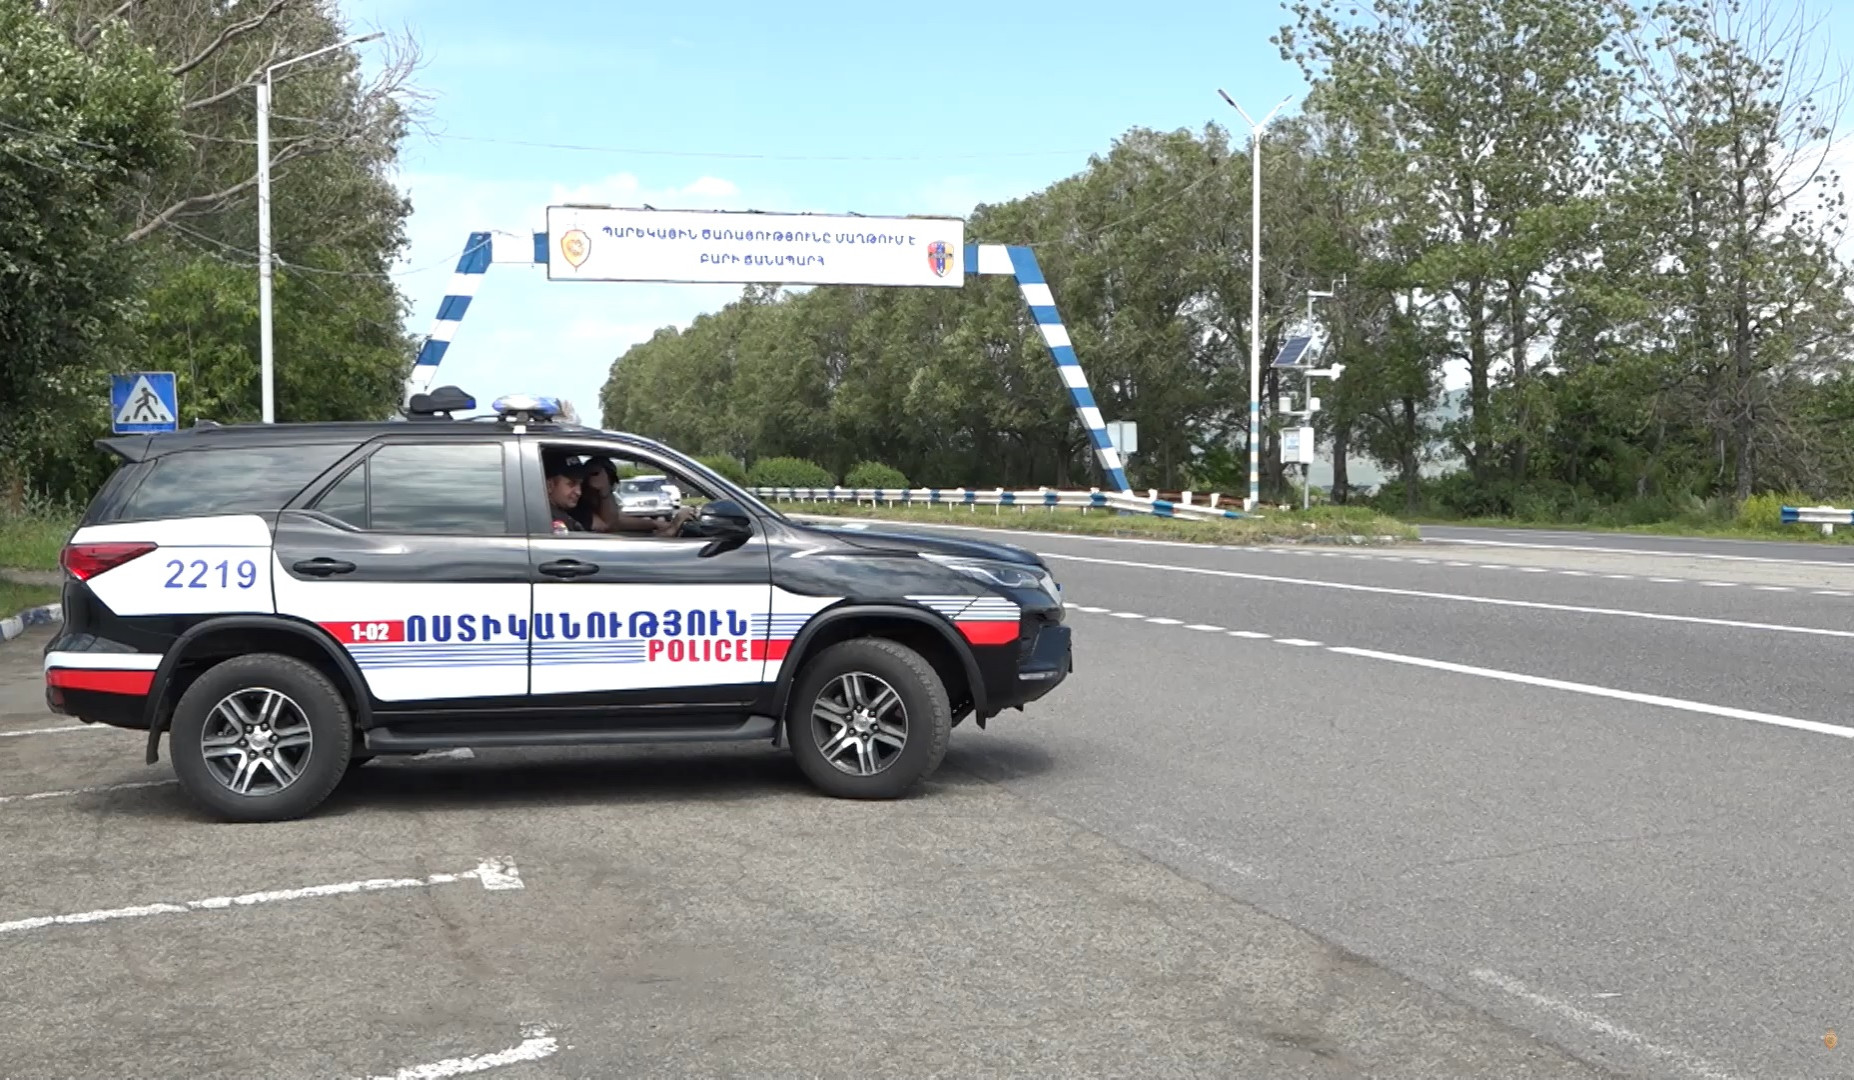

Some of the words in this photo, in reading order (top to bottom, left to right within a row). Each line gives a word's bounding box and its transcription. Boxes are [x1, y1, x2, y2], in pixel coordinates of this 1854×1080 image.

[601, 225, 698, 240] ՊԱՐԵԿԱՅԻՆ
[701, 228, 832, 244] ԾԱՌԱՅՈՒԹՅՈՒՆԸ
[835, 232, 905, 246] ՄԱՂԹՈՒՄ
[908, 235, 917, 246] Է
[700, 252, 741, 265] ԲԱՐԻ
[743, 254, 825, 267] ՃԱՆԱՊԱՐՀ
[163, 559, 257, 590] 2219
[350, 622, 390, 641] 1-02
[406, 609, 747, 643] ՈՍՏԻԿԱՆՈՒԹՅՈՒՆ
[648, 638, 748, 663] POLICE
